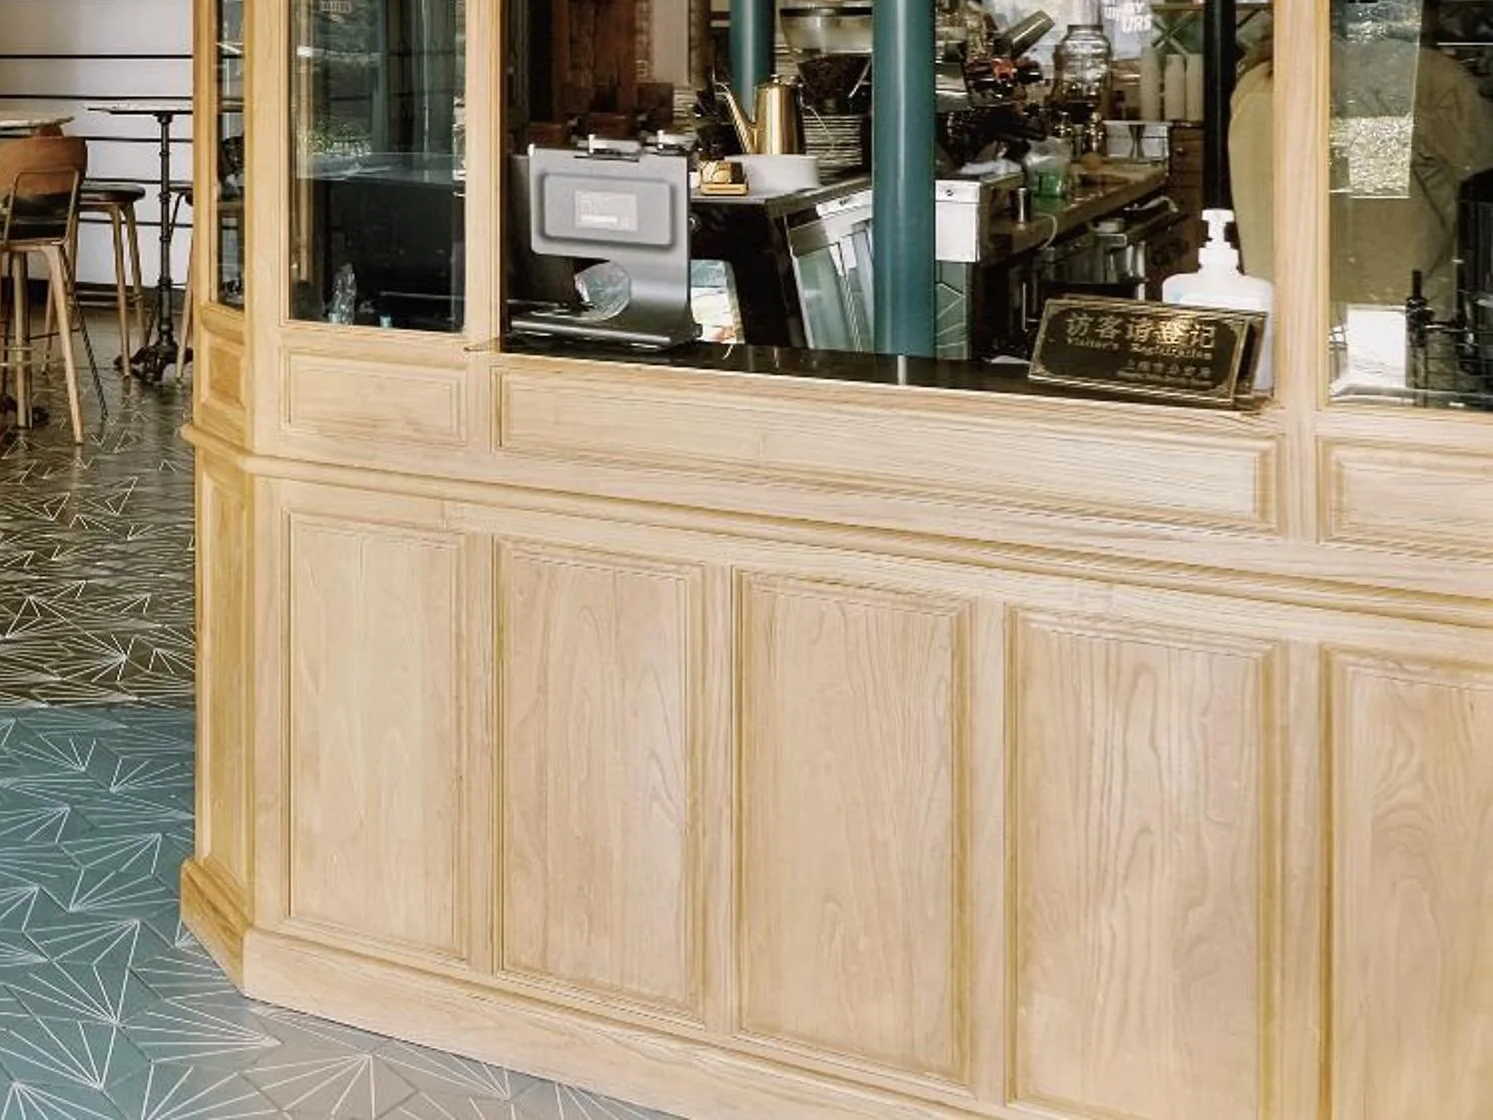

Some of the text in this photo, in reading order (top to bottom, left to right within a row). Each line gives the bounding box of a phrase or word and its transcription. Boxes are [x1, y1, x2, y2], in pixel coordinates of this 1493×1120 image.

[1066, 311, 1215, 348] 访客请登记
